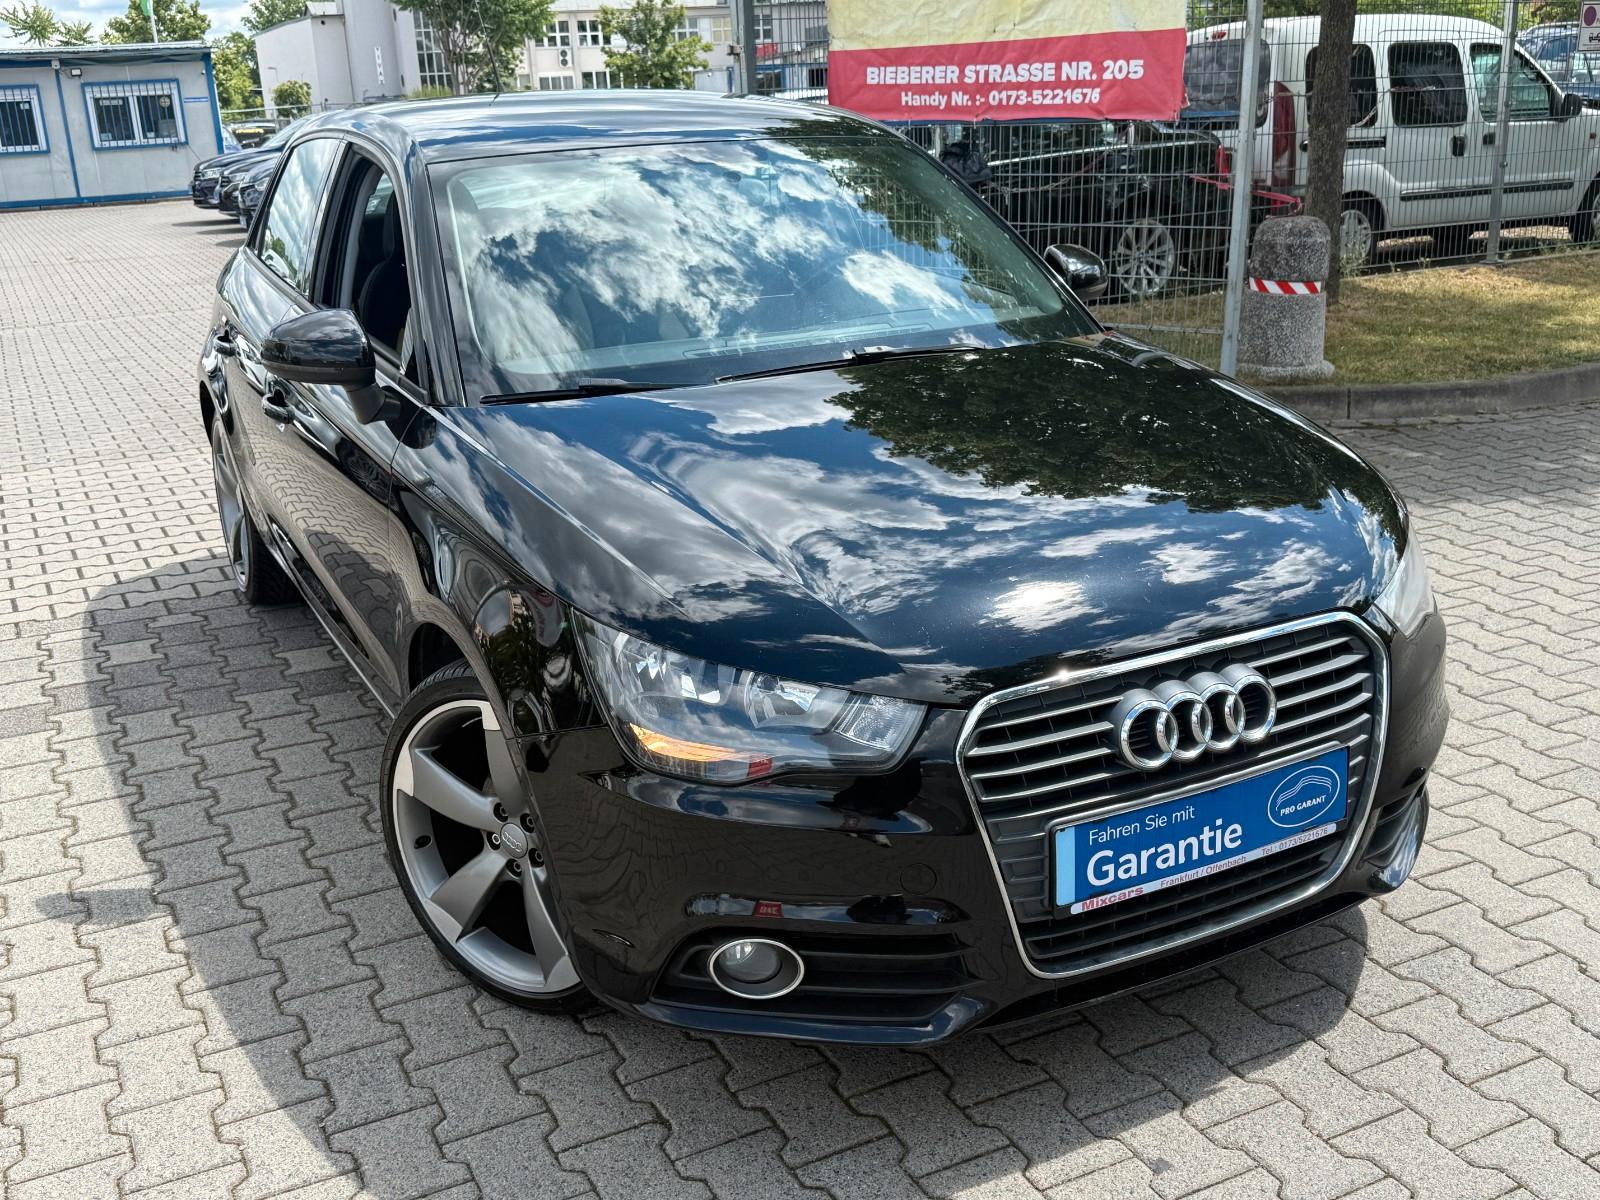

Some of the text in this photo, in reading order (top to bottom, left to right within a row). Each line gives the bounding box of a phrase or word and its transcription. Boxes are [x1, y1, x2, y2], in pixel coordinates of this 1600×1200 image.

[866, 59, 1144, 85] BIEBERER STRASSE NR. 205
[901, 91, 948, 110] Handy
[951, 91, 972, 106] Nr.
[988, 88, 1100, 106] 0173-5221676
[1280, 794, 1327, 817] PRO GARANT
[1089, 805, 1196, 846] Fahren Sie mit
[1086, 818, 1243, 886] Garantie
[1081, 886, 1144, 912] Mixcars
[1160, 870, 1200, 889] Frankfurt
[1205, 856, 1248, 874] Offenbach
